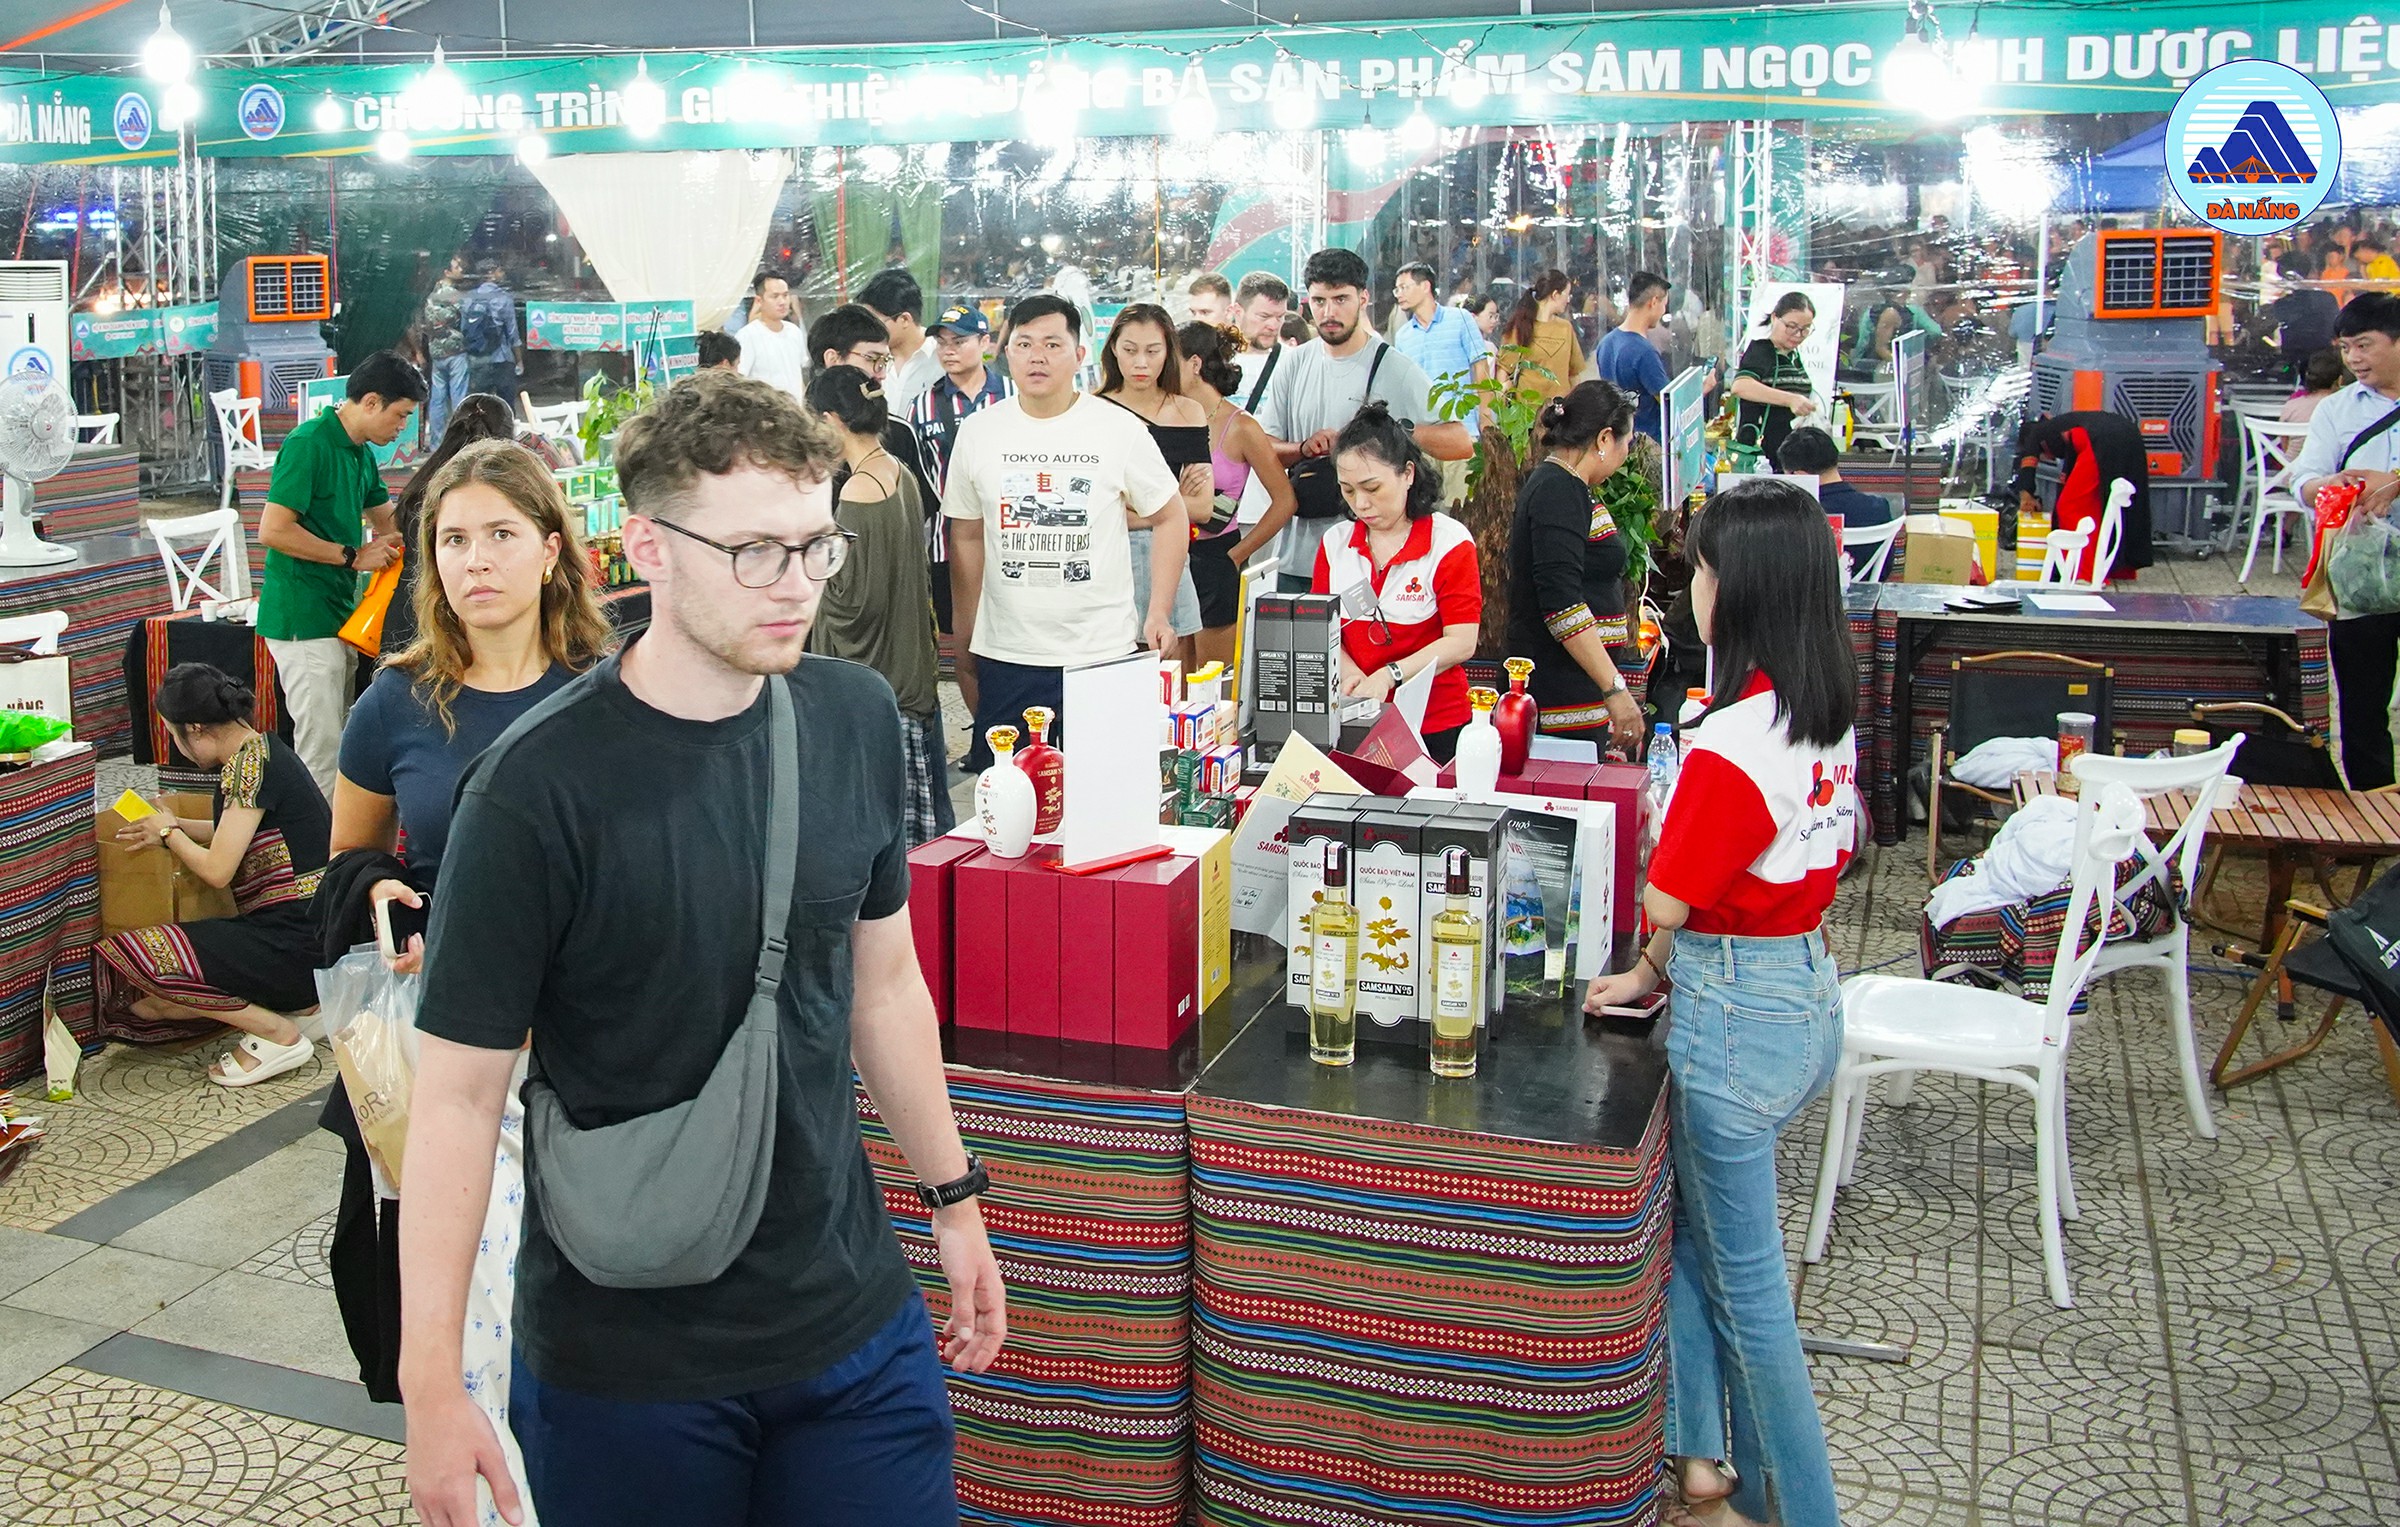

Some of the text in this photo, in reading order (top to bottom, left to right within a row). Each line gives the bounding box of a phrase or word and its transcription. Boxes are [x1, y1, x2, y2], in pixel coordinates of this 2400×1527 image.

[354, 93, 523, 131] CHNG
[1230, 49, 1340, 102] SẢN
[1361, 39, 1526, 98] PHẨM
[1547, 42, 1682, 93] SÂM
[1703, 43, 1873, 97] NGỌC
[2067, 28, 2252, 87] DƯỢC
[1002, 454, 1099, 464] TOKYO AUTOS
[1012, 532, 1026, 550] THE
[1029, 533, 1063, 551] STREET
[1065, 532, 1090, 552] BEAST
[1300, 775, 1321, 793] SAMSA
[1361, 982, 1393, 993] SAMSAM
